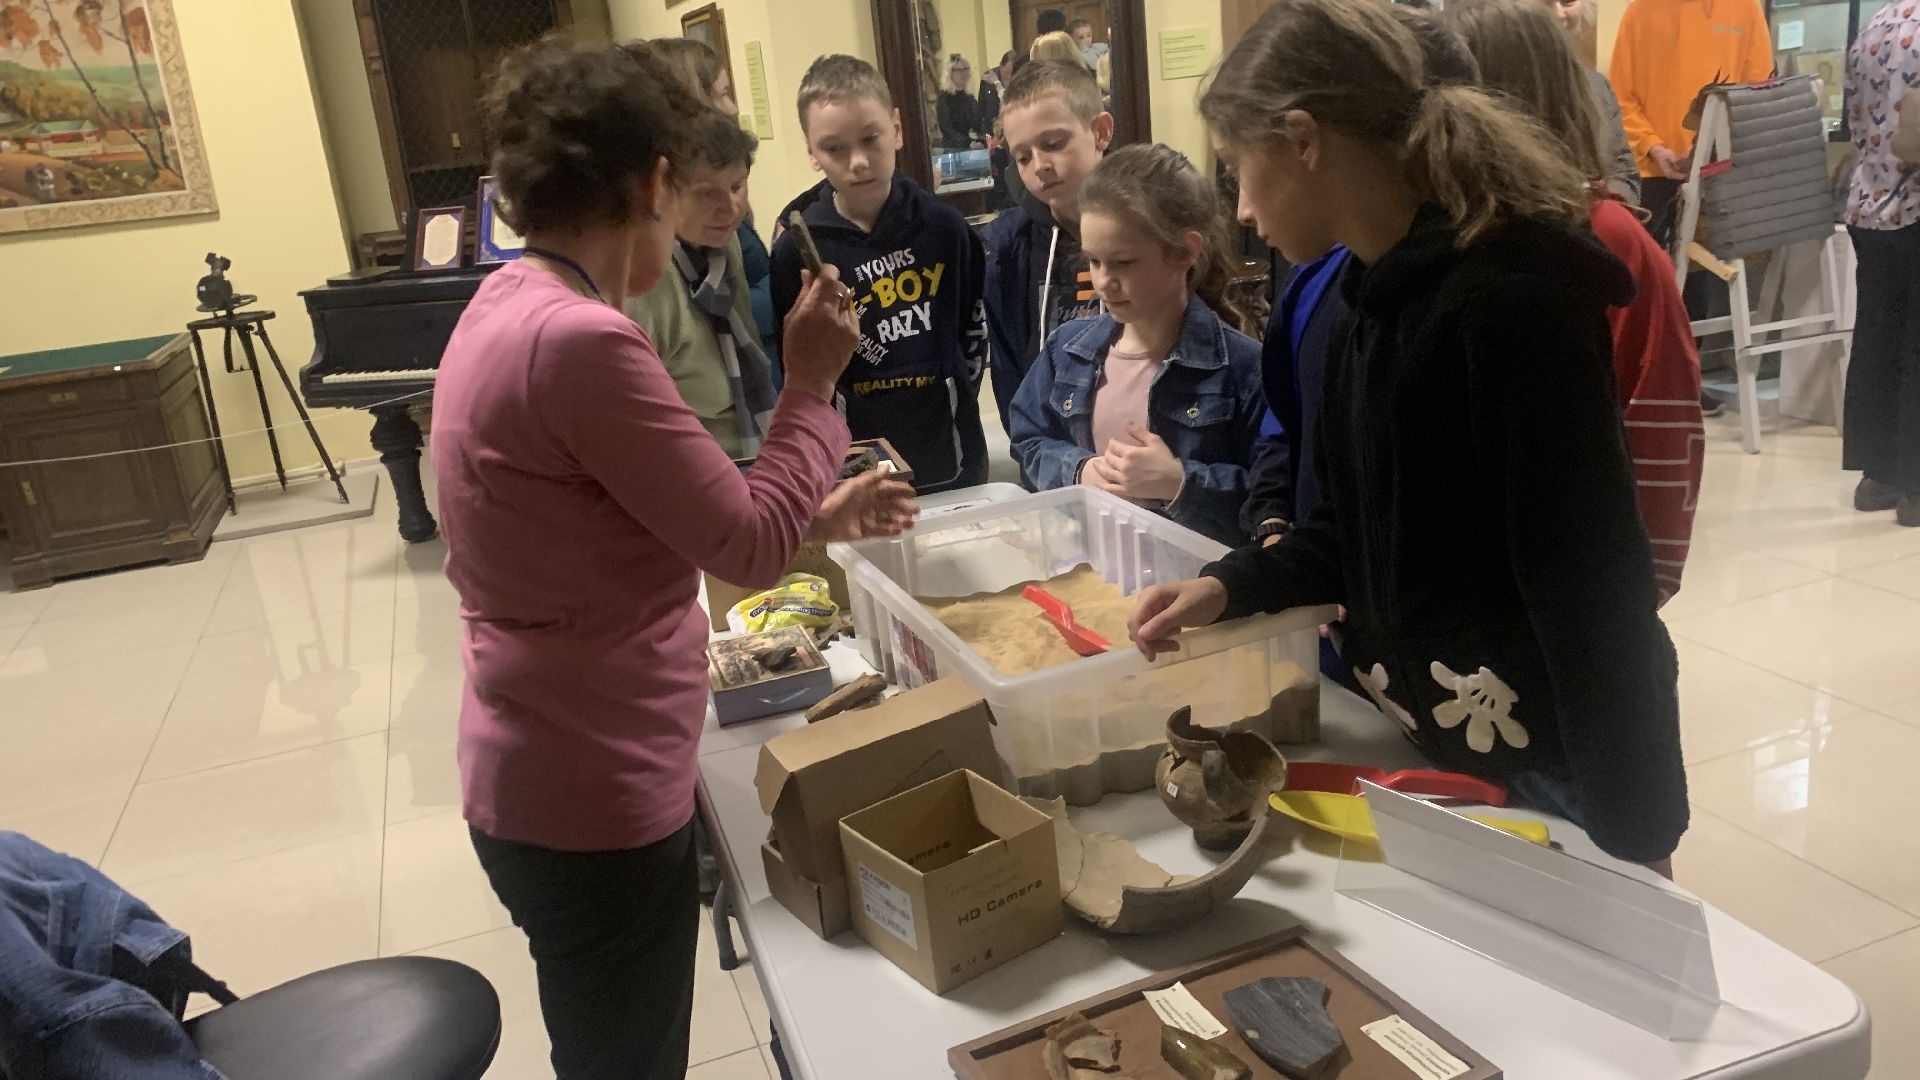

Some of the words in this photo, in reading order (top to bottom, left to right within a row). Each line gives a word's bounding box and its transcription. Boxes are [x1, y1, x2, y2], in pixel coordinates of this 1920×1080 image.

[861, 248, 915, 283] YOURS
[877, 302, 932, 344] RAZY
[860, 333, 889, 358] EALITY
[862, 350, 882, 366] JUST
[853, 377, 914, 396] REALITY
[958, 908, 981, 926] HD
[987, 879, 1042, 912] Camera
